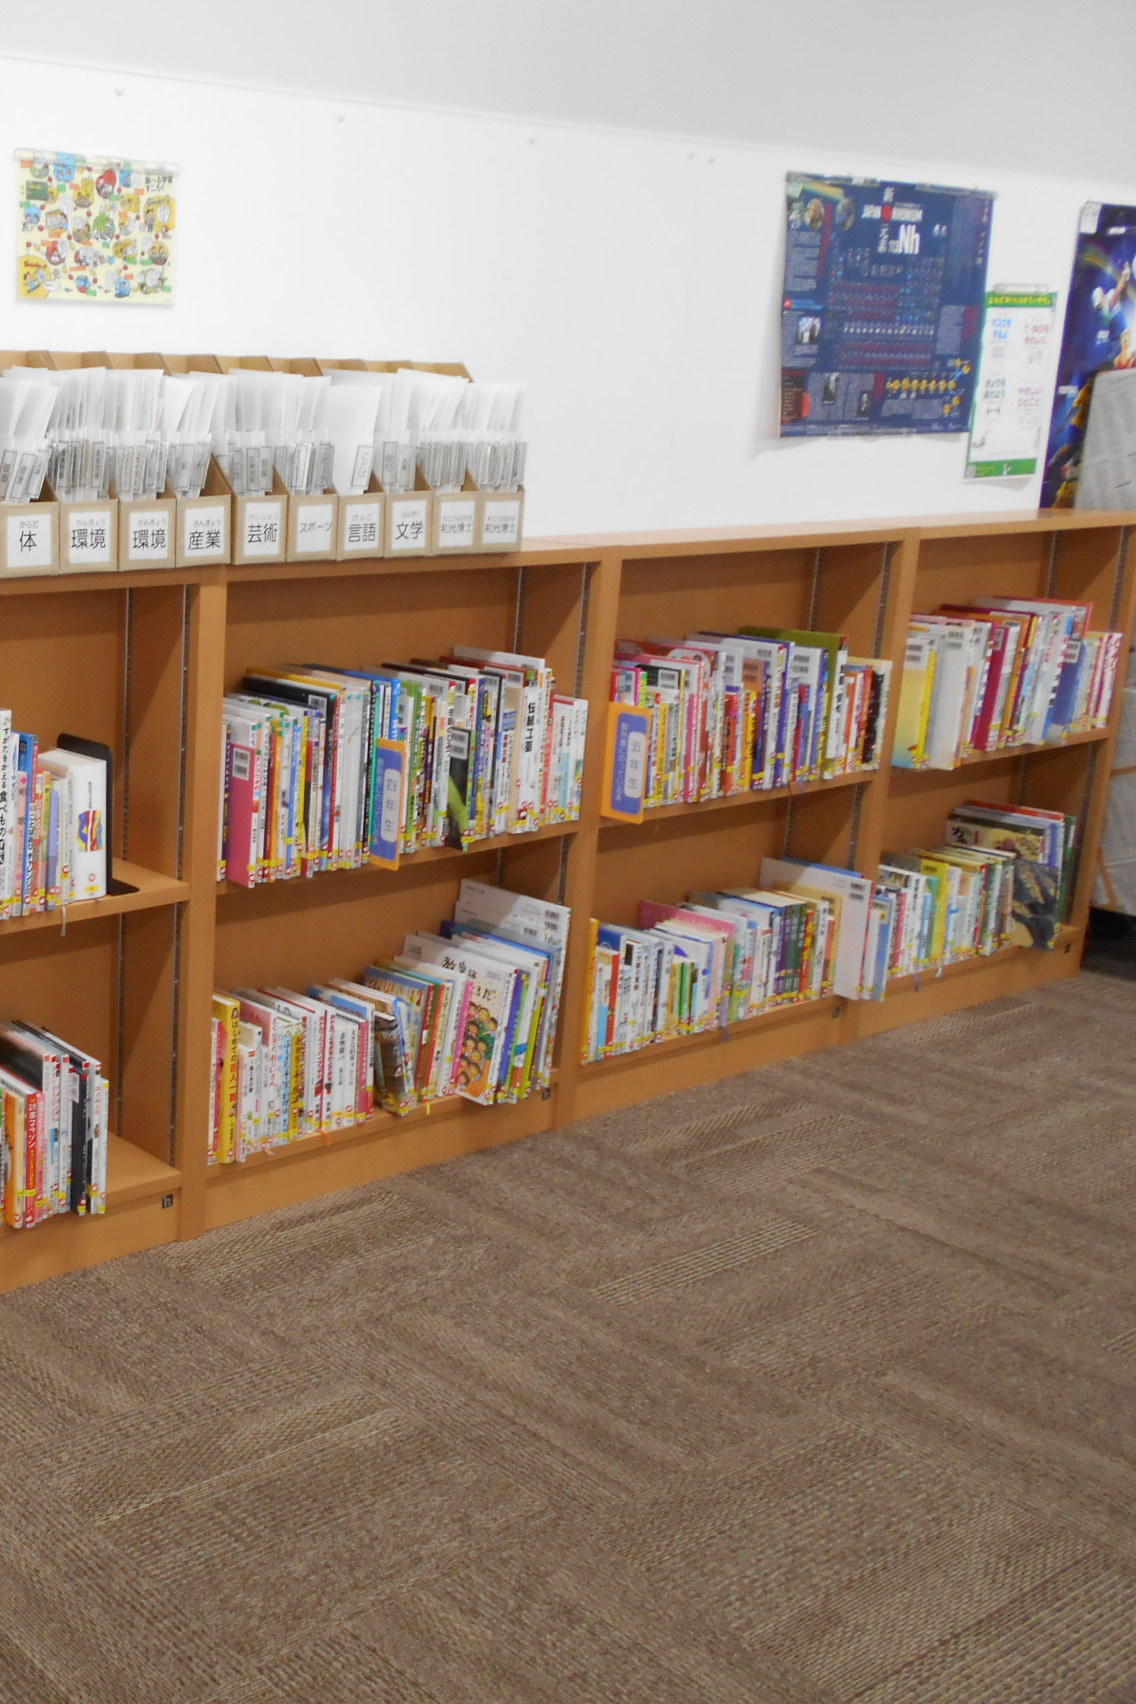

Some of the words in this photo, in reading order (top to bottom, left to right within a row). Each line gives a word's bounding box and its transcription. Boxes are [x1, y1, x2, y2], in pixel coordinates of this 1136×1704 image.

[247, 522, 279, 543] 芸術
[298, 520, 334, 533] スポーツ
[347, 522, 377, 543] 言語
[395, 520, 424, 541] 文学
[19, 530, 38, 552] 体
[71, 528, 107, 550] 環境
[131, 528, 167, 550] 環境
[188, 529, 222, 550] 産業
